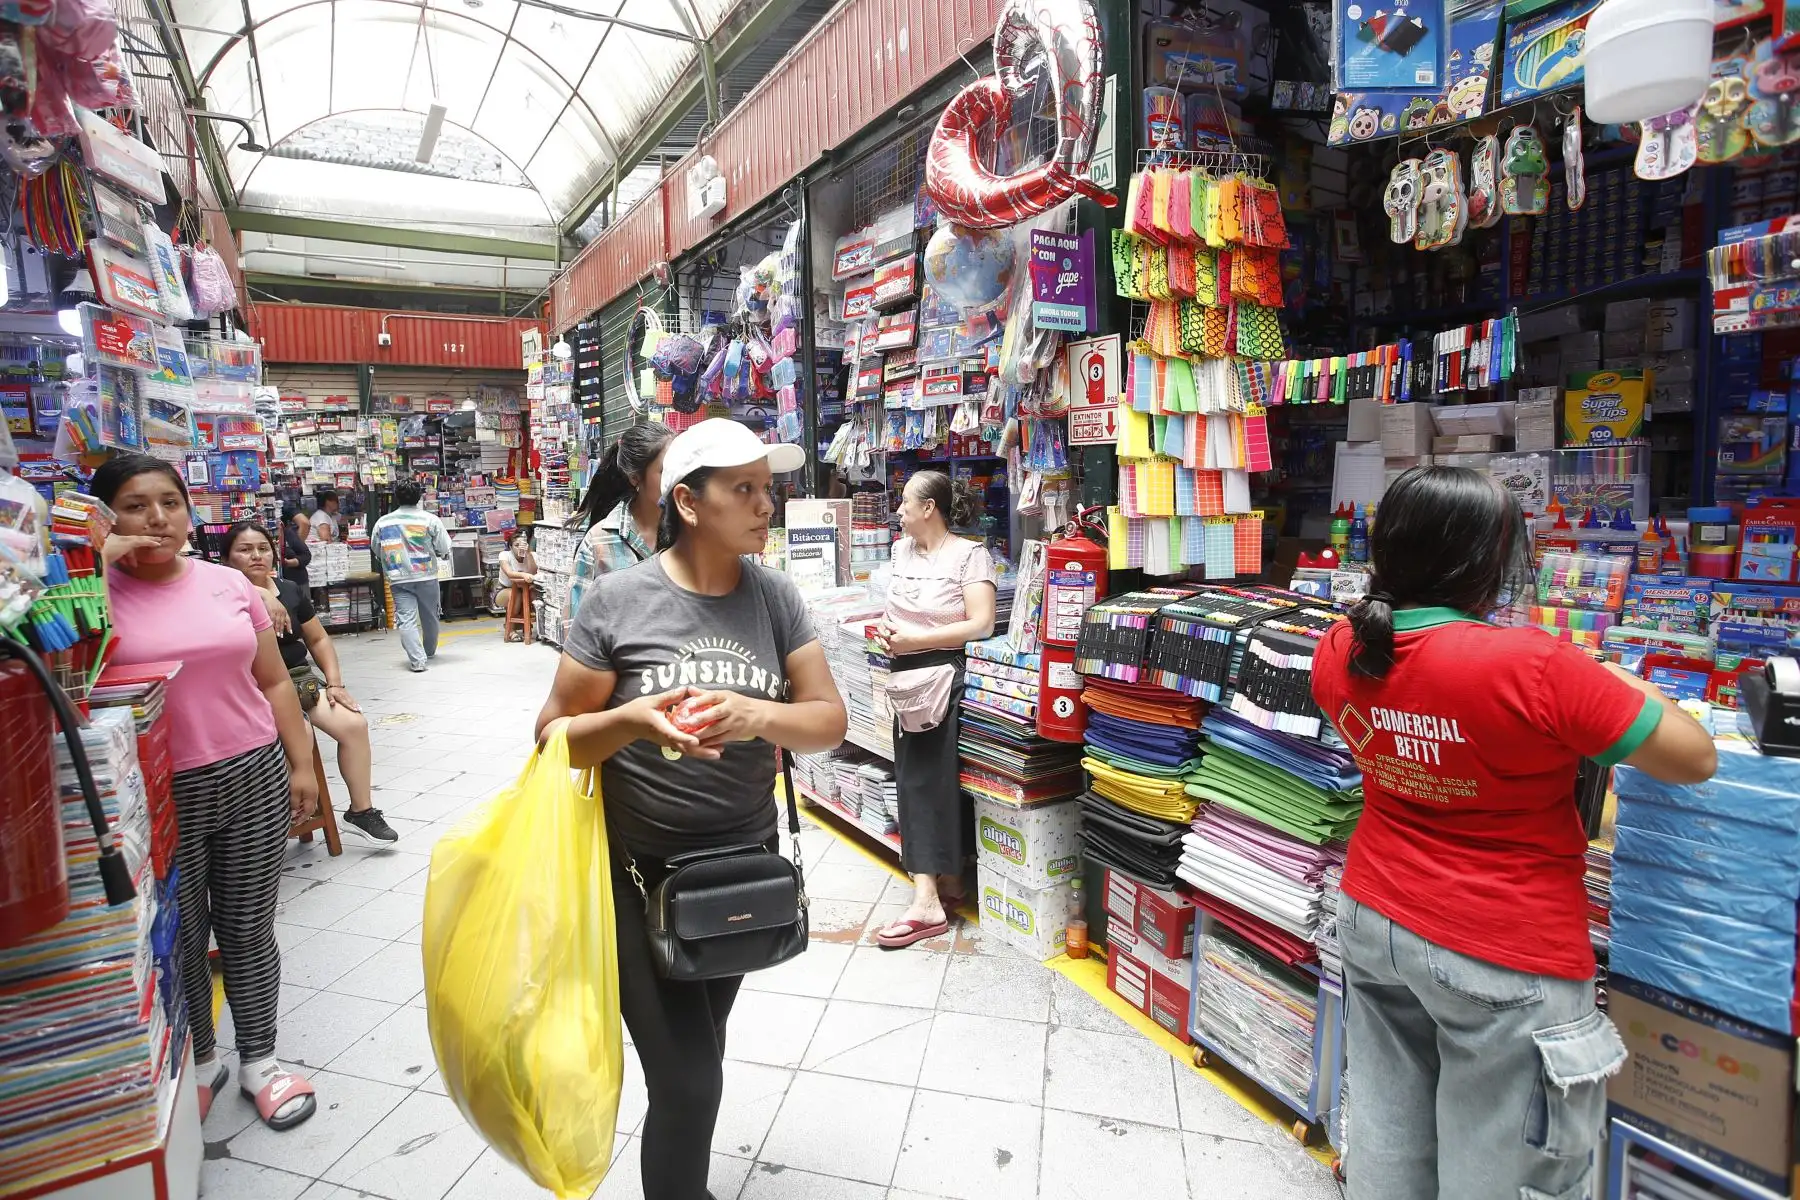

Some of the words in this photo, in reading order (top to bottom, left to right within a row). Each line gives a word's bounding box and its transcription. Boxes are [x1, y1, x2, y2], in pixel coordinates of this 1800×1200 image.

[1033, 234, 1057, 247] PAGA
[1057, 238, 1079, 250] AQUÍ
[1038, 250, 1056, 261] CON
[1055, 272, 1079, 294] yape
[1039, 307, 1059, 316] AHORA
[1059, 309, 1079, 318] TODOS
[1037, 315, 1061, 324] PUEDEN
[1060, 317, 1082, 326] YAPEAR
[443, 343, 465, 353] 127
[1093, 366, 1100, 379] 3
[1581, 398, 1624, 409] Super
[1073, 412, 1102, 421] EXTINTOR
[1601, 407, 1628, 418] Tips
[1590, 429, 1612, 439] 100
[792, 532, 831, 542] Bitácora
[1644, 589, 1691, 597] MERCYFAN
[640, 660, 780, 699] SUNSHINE
[1059, 700, 1067, 713] 3
[1370, 706, 1466, 743] COMERCIAL
[1394, 734, 1441, 766] BETTY
[1401, 777, 1433, 792] CAMPAÑA
[1436, 786, 1478, 797] NAVIDEÑA
[1441, 777, 1478, 788] ESCOLAR
[1414, 789, 1450, 803] FESTIVOS
[983, 824, 1021, 851] alpha
[1049, 857, 1073, 871] alpha
[1629, 984, 1764, 1040] CUADERNOS
